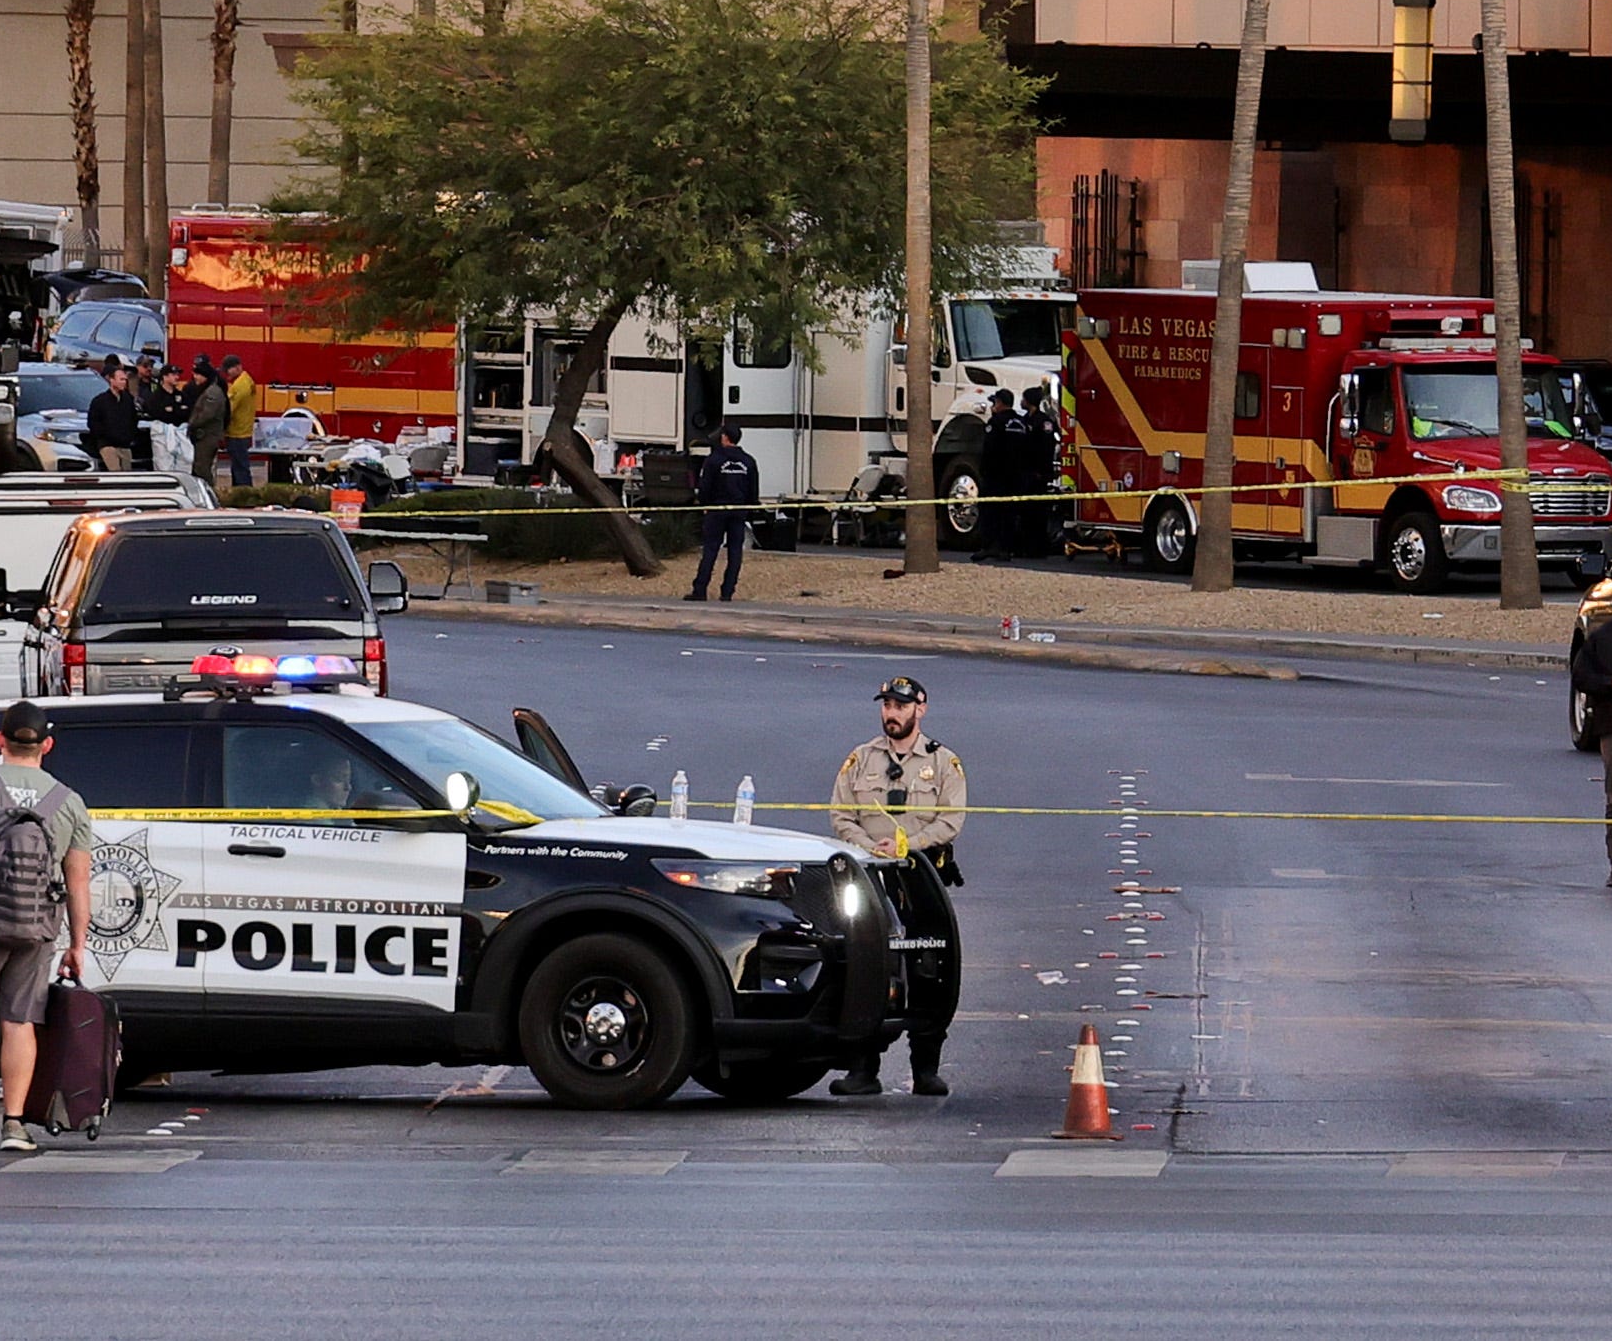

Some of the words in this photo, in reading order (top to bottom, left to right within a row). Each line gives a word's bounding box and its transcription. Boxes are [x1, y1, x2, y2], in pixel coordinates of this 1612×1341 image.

[1119, 316, 1152, 336] LAS
[1118, 344, 1148, 359] FIRE
[1152, 346, 1161, 360] &
[1169, 347, 1212, 362] RESCU
[1134, 365, 1202, 380] PARAMEDICS
[1282, 391, 1292, 412] 3
[190, 595, 257, 605] LEGEND
[229, 826, 307, 840] TACTICAL
[312, 828, 383, 843] VEHICLE
[484, 844, 525, 856] Partners
[527, 846, 550, 856] with
[551, 846, 569, 857] the
[570, 847, 629, 861] Community
[107, 861, 140, 887] VEGAS
[179, 895, 213, 907] LAS
[223, 897, 285, 910] VEGAS
[295, 899, 446, 916] METROPOLITAN
[175, 918, 449, 978] POLICE
[917, 939, 947, 949] POLICE
